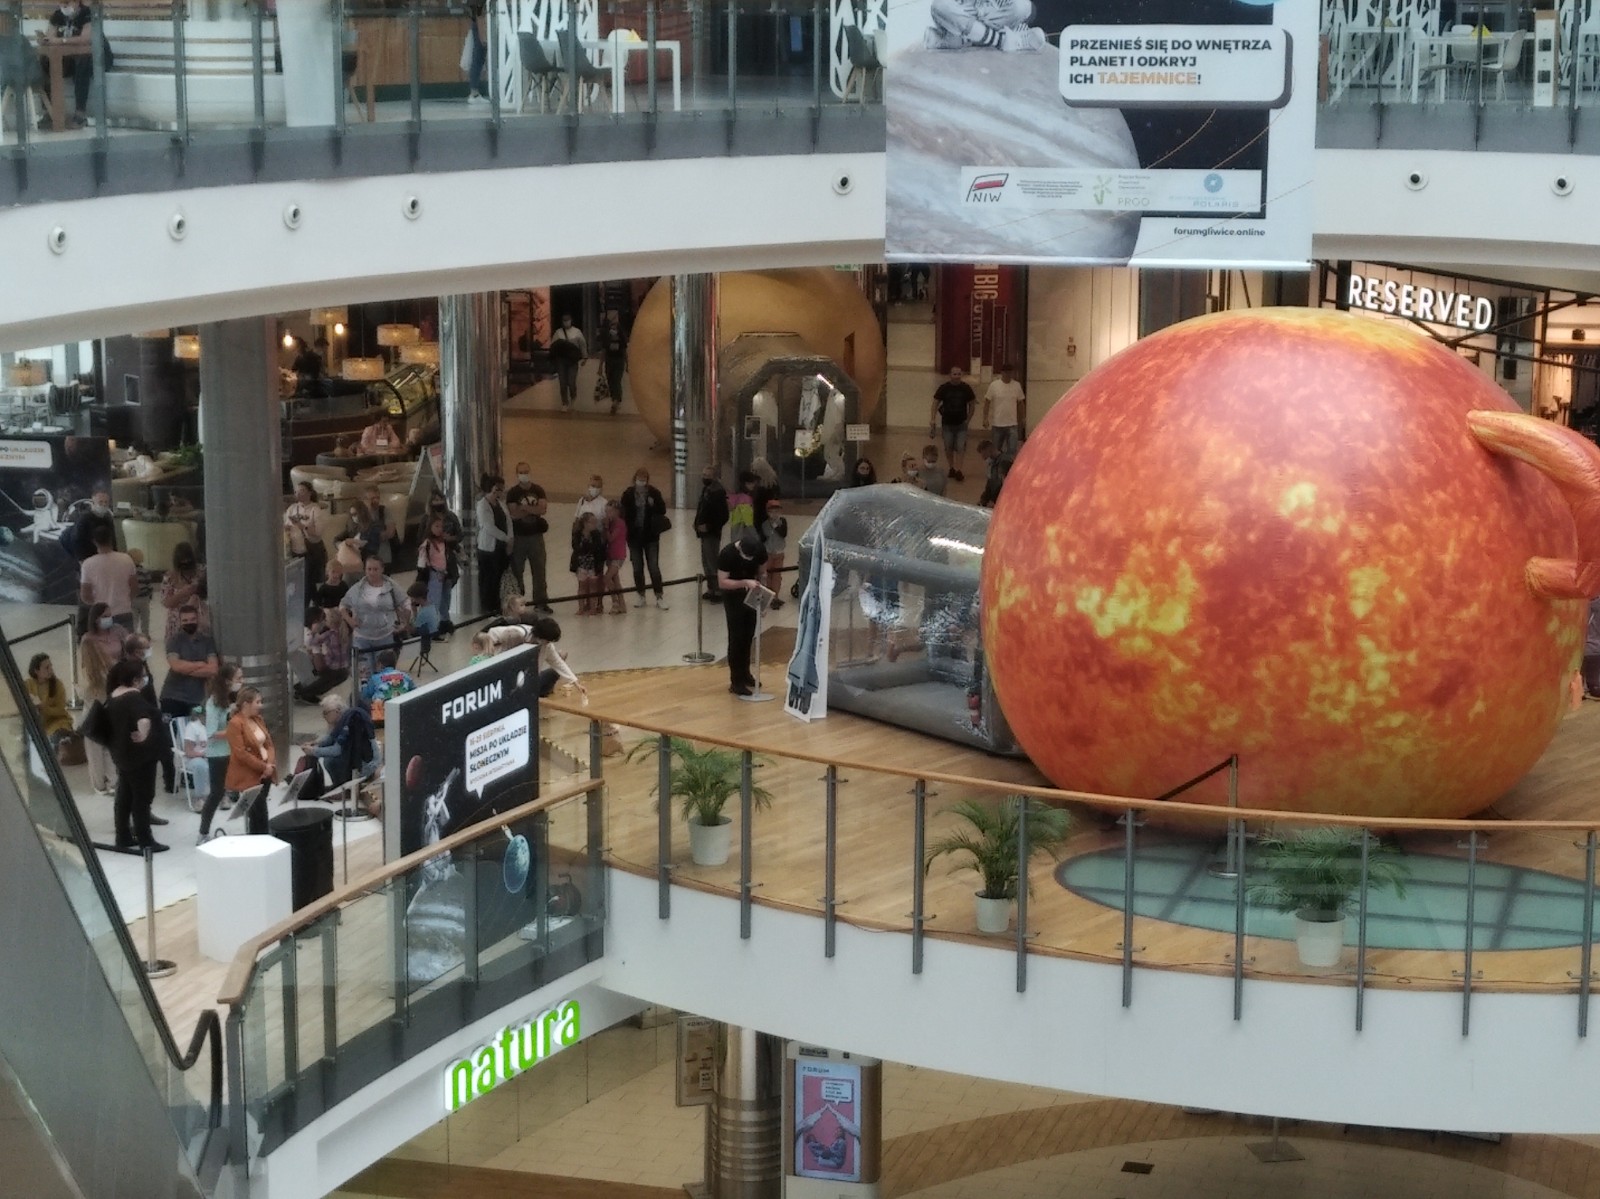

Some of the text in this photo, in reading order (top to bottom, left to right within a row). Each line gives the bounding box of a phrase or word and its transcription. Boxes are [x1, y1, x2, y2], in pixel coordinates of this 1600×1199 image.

[1070, 36, 1272, 53] PRZENIEŚ SIĘ DO WNĘTRZA
[1070, 56, 1197, 67] PLANET I ODKRYJ
[1069, 72, 1201, 85] ICH TAJEMNICE!
[972, 192, 1001, 203] NIW
[1174, 227, 1266, 237] forumgliwice.online
[1348, 274, 1494, 331] RESERVED
[442, 680, 502, 724] FORUM
[469, 744, 488, 760] MISJA
[489, 739, 498, 751] PO
[445, 1000, 580, 1111] natura
